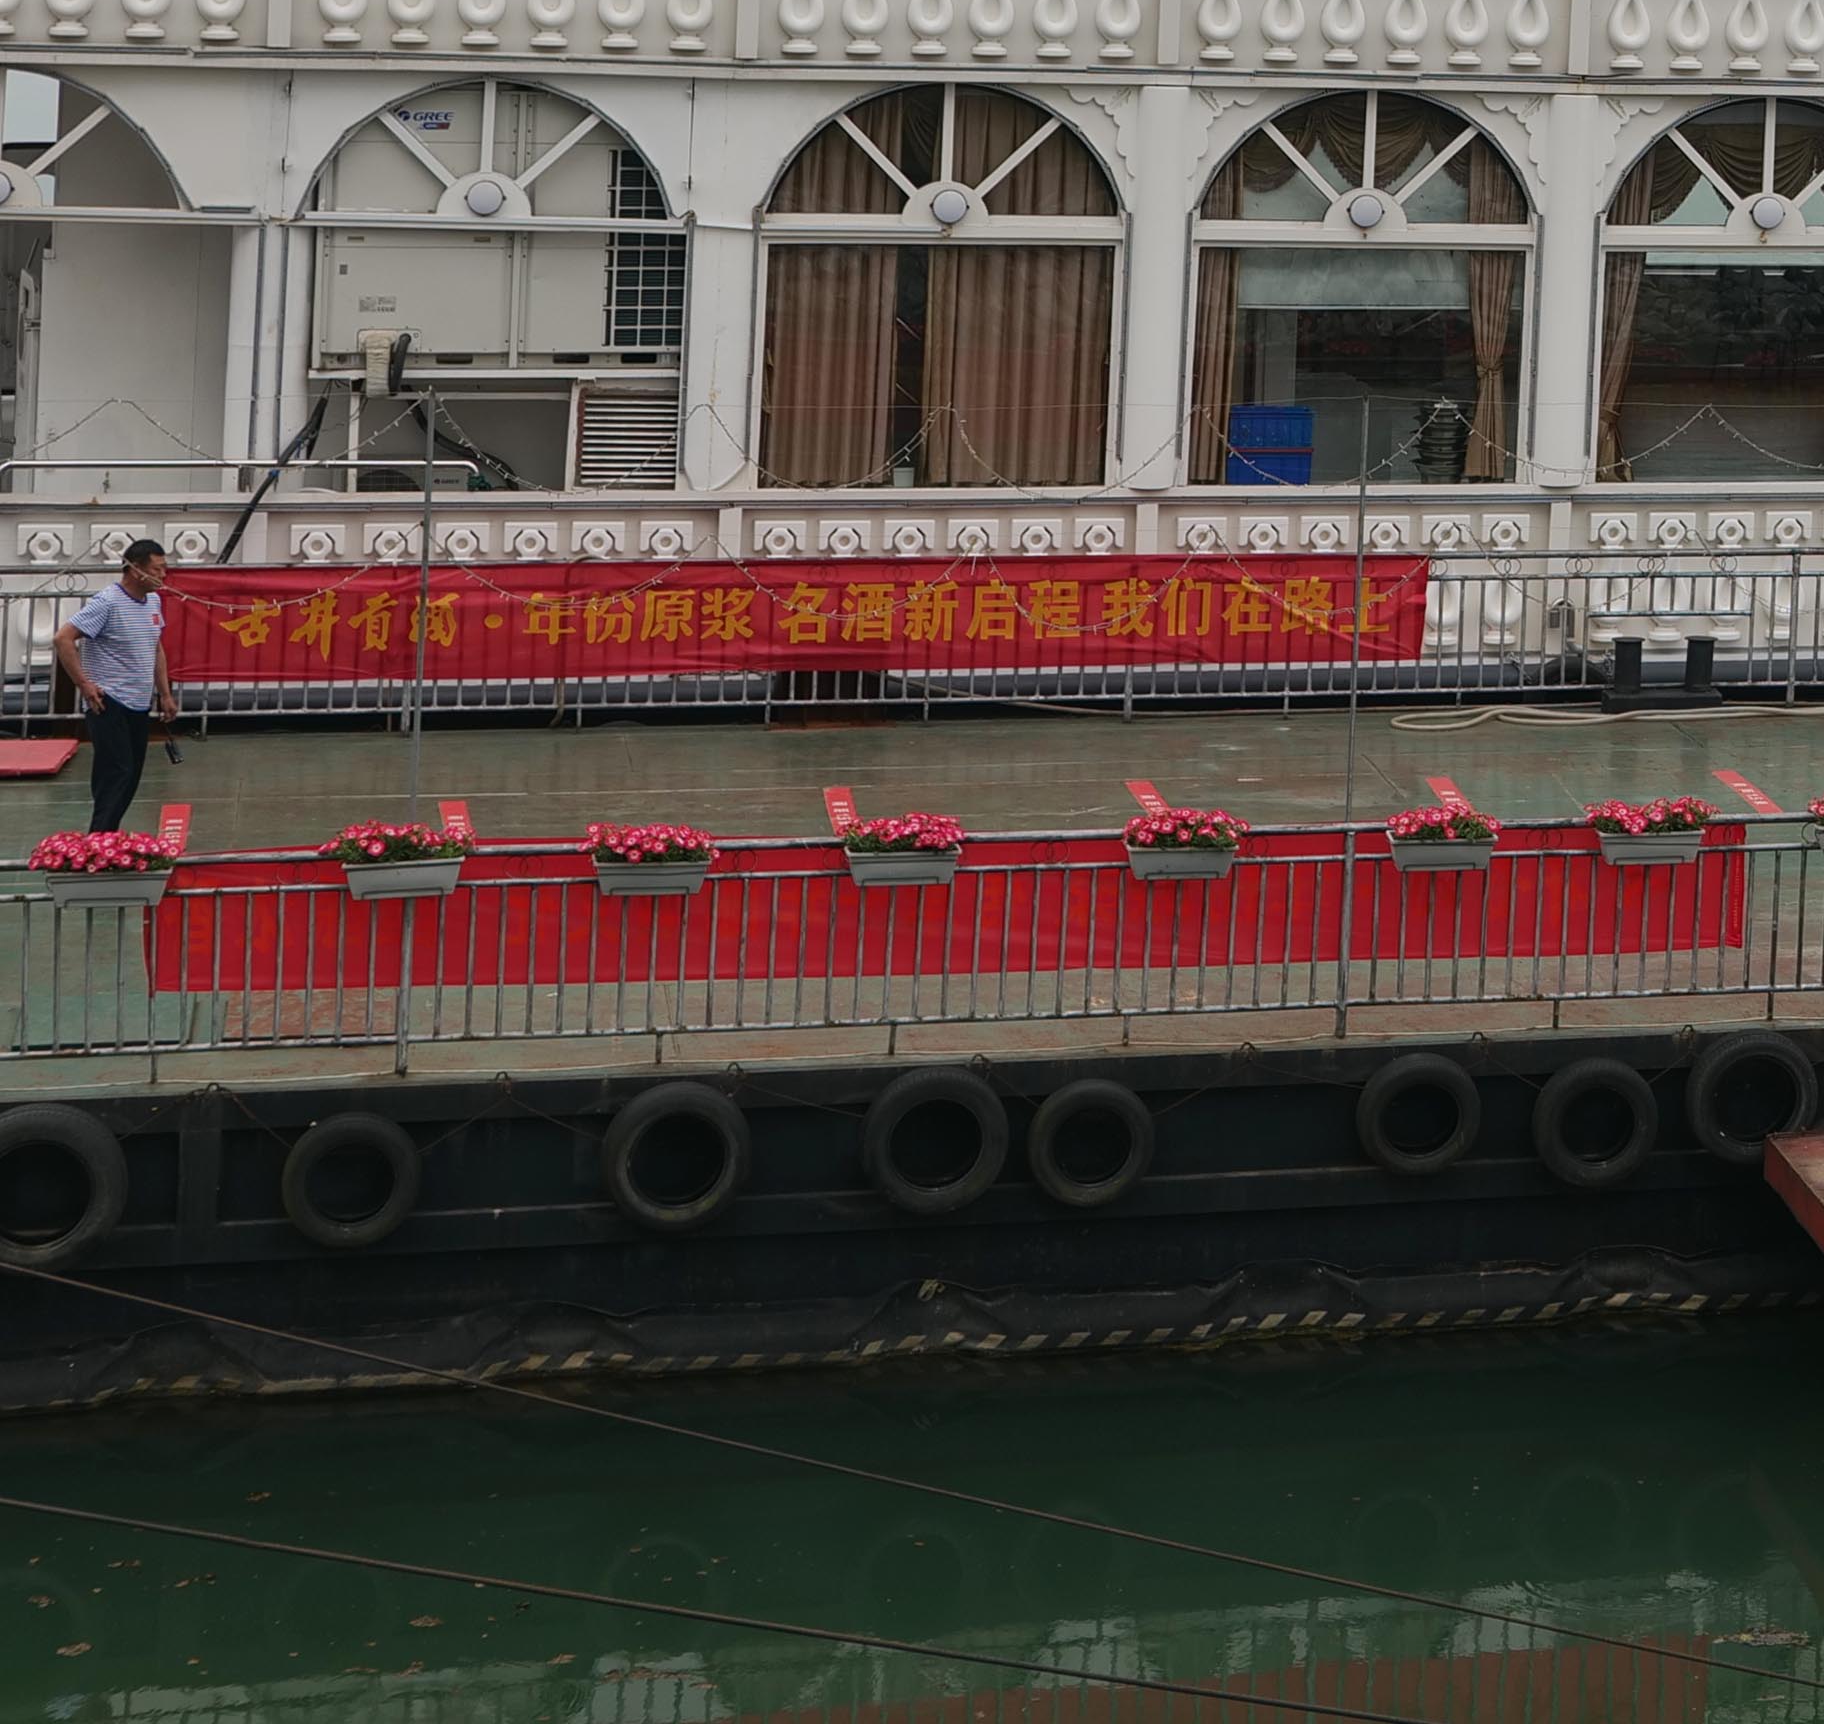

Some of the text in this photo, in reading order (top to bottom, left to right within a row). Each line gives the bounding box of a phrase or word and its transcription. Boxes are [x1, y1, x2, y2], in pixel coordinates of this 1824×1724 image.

[413, 111, 455, 122] GREE
[777, 577, 1081, 645] 名酒新启程
[1102, 575, 1390, 640] 我们在路上
